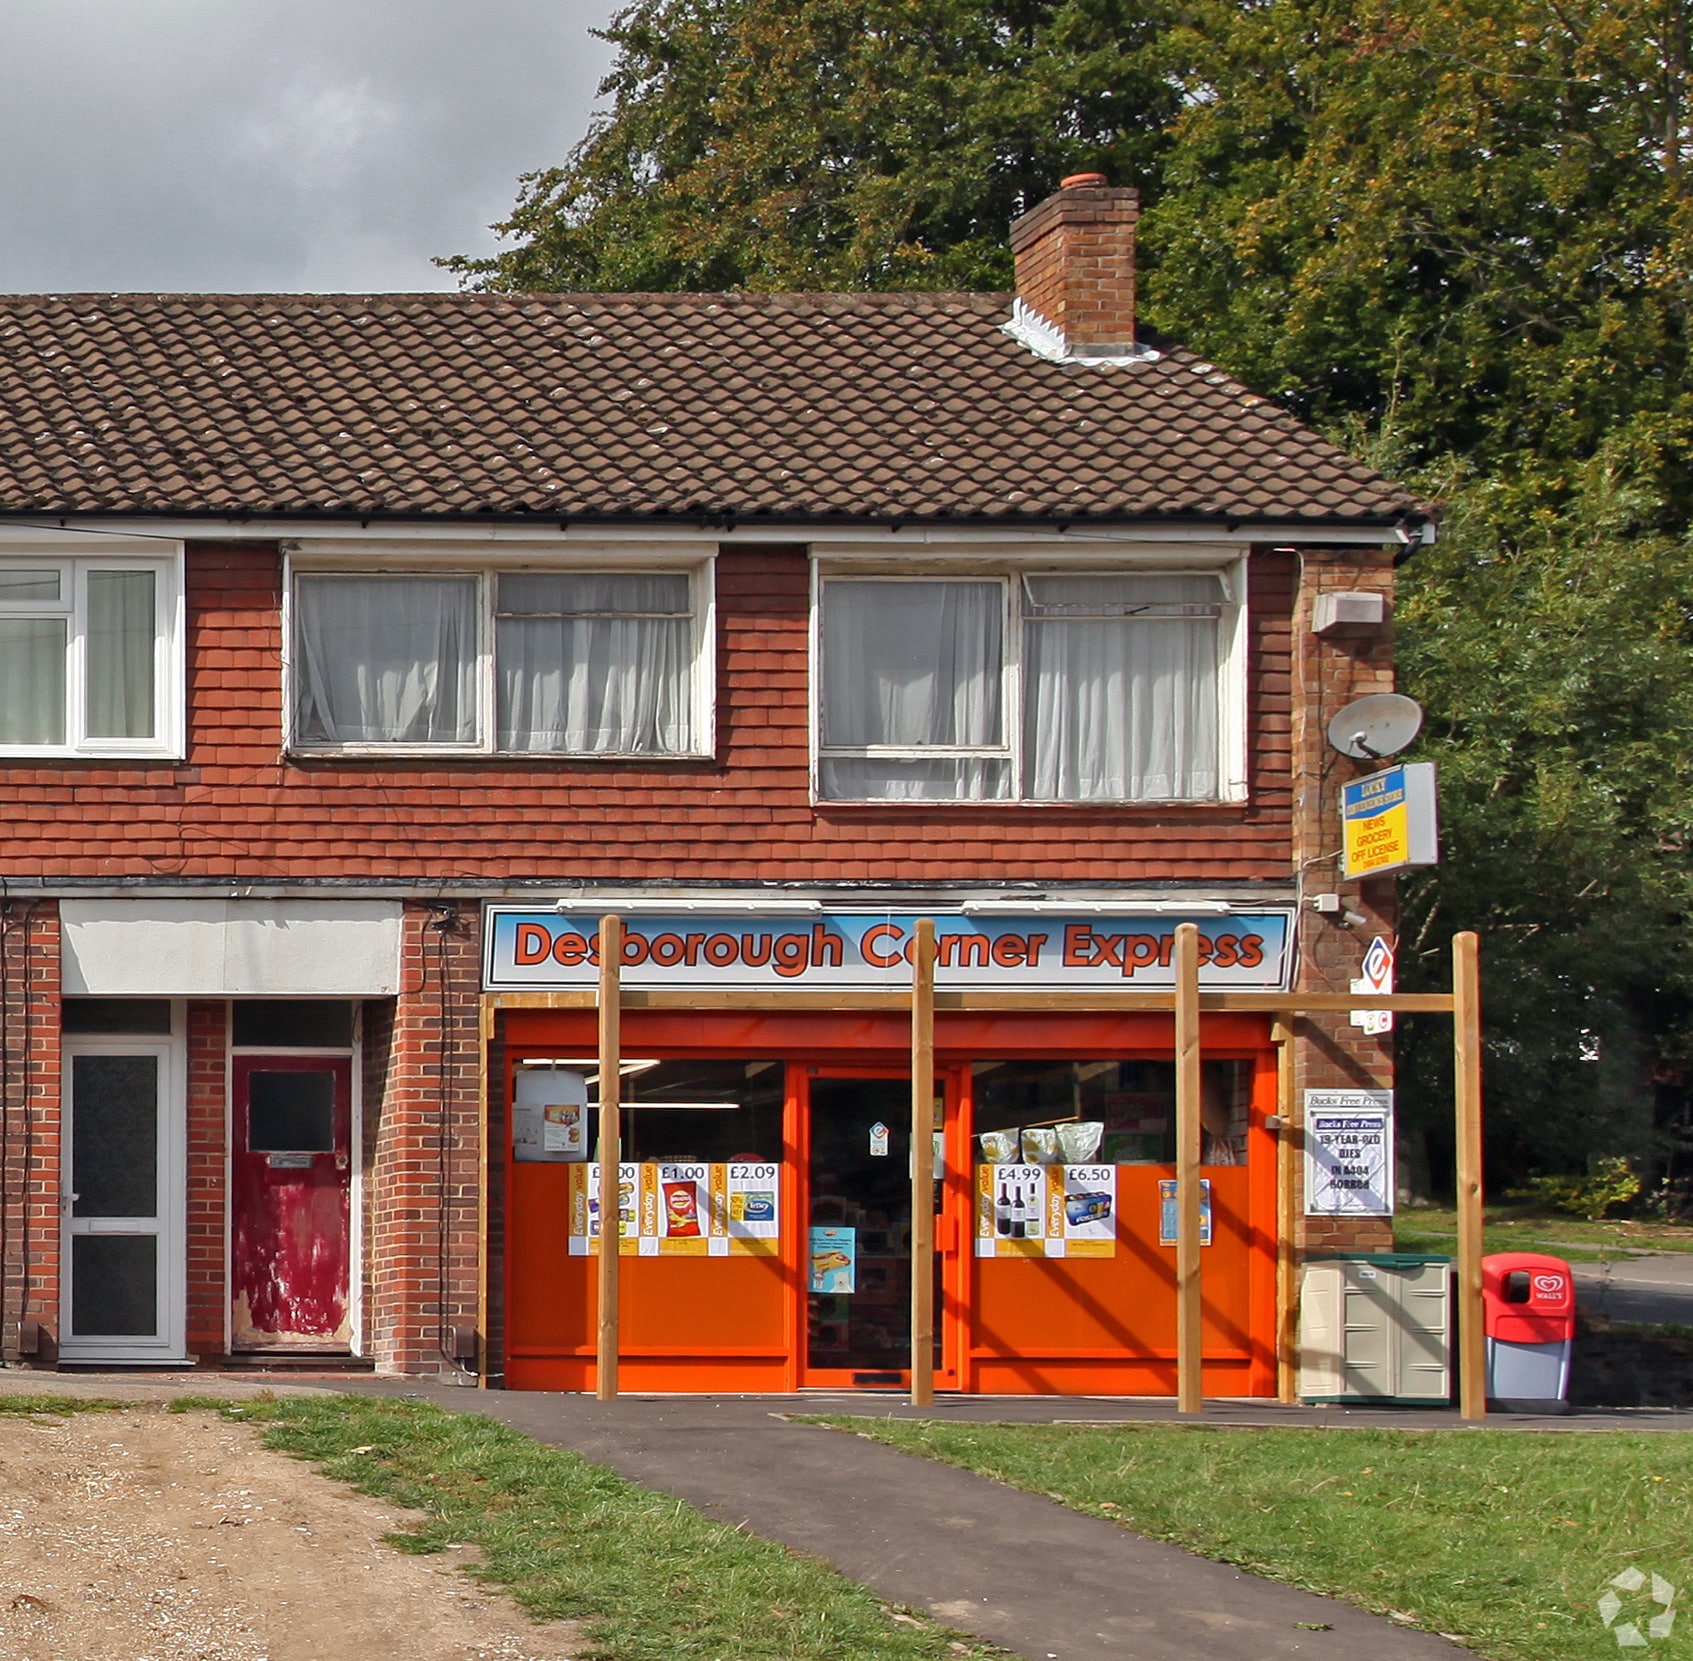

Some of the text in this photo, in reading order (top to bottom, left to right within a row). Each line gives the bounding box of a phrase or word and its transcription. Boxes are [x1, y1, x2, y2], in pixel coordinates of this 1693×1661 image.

[1363, 816, 1386, 830] NEWS
[1357, 828, 1392, 847] GROCERY
[1352, 849, 1366, 863] OFF
[1368, 840, 1400, 858] LICENSE
[513, 922, 844, 978] Desborough
[1311, 1096, 1388, 1105] Bucks Free Press
[1339, 1149, 1361, 1159] DIES
[592, 1167, 635, 1179] £00
[662, 1167, 704, 1179] £1.00
[730, 1166, 775, 1179] £2.09
[998, 1168, 1041, 1180] £4.99
[1069, 1168, 1110, 1180] £6.50
[574, 1165, 585, 1235] Everyday value
[643, 1166, 655, 1235] Everyday value
[713, 1165, 725, 1236] Everyday value
[980, 1166, 992, 1237] Everyday value
[1050, 1167, 1062, 1236] Everyday value
